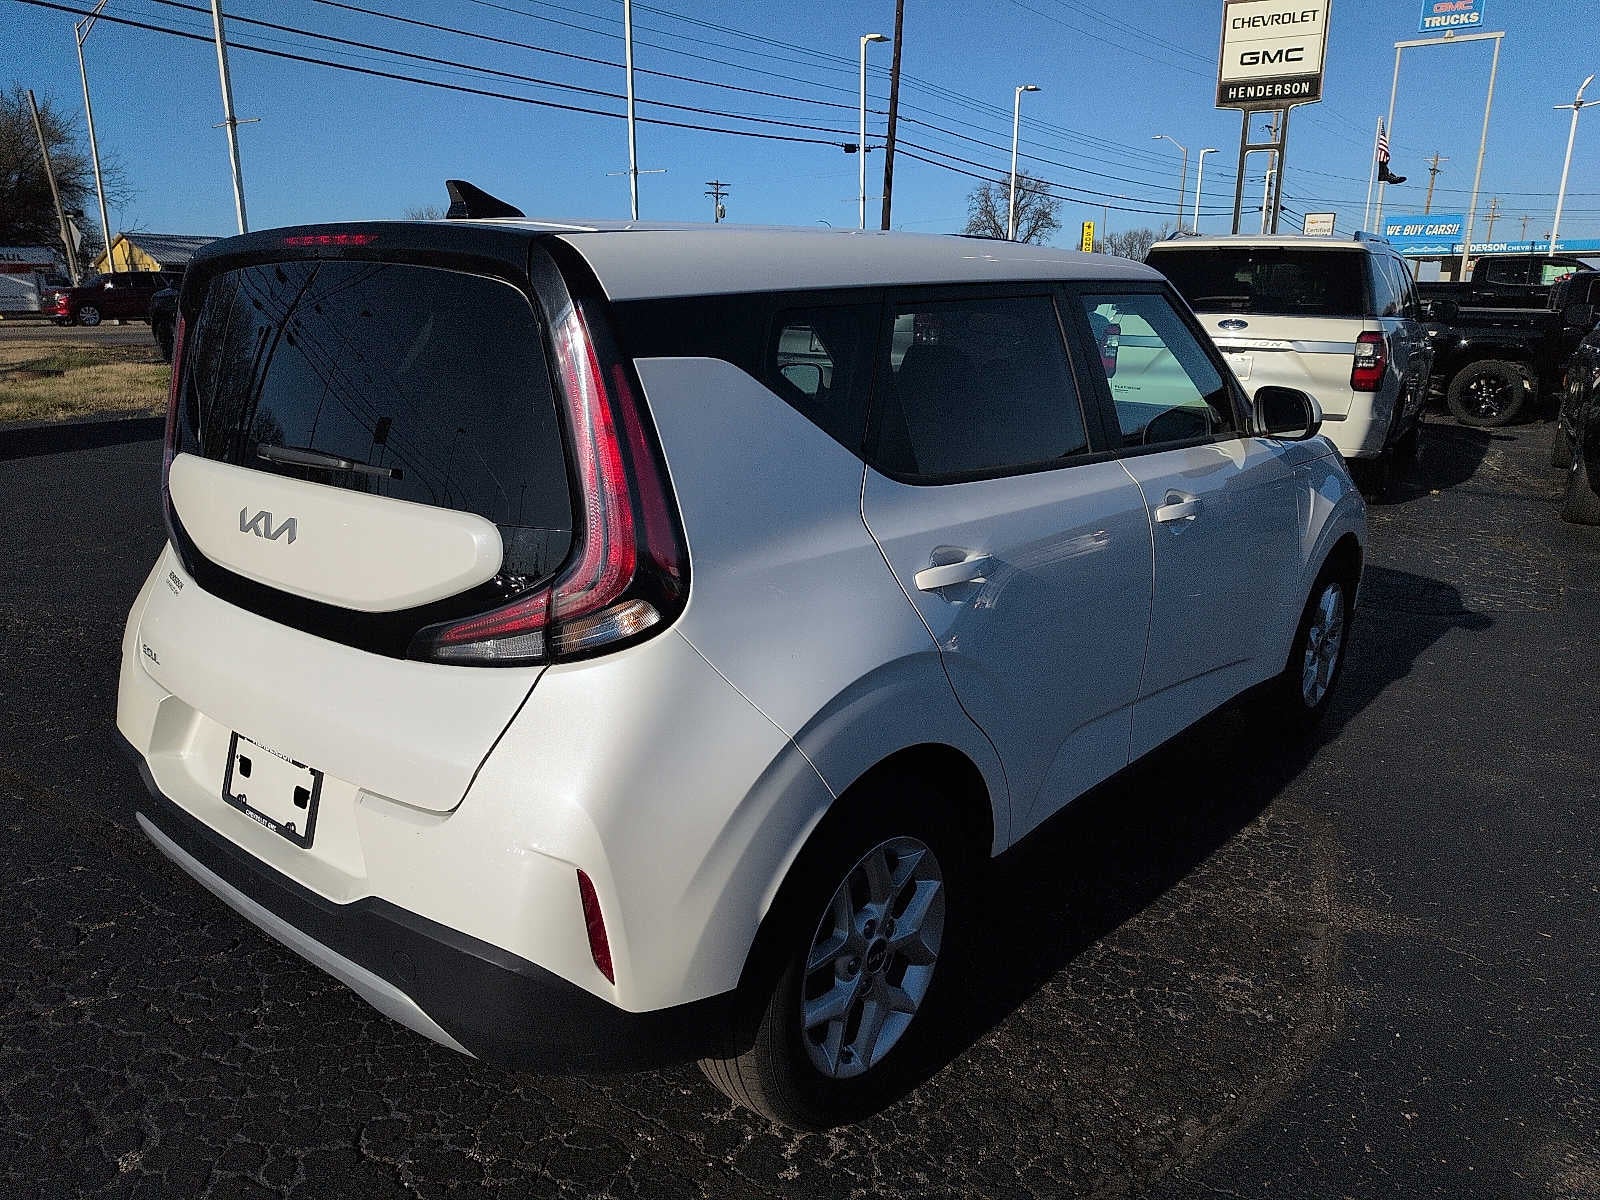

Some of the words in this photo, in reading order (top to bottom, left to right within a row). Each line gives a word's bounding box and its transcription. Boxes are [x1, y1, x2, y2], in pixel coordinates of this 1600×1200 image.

[1433, 0, 1473, 13] GMC
[1232, 9, 1320, 30] CHEVROLET
[1424, 12, 1479, 28] TRUCKS
[1240, 47, 1304, 66] GMC
[1228, 82, 1310, 99] HENDERSON
[1386, 225, 1402, 236] WE
[1402, 224, 1424, 236] BUY
[1425, 223, 1460, 236] CARS!!
[1453, 243, 1507, 252] HEDERSON
[240, 506, 298, 544] KIA
